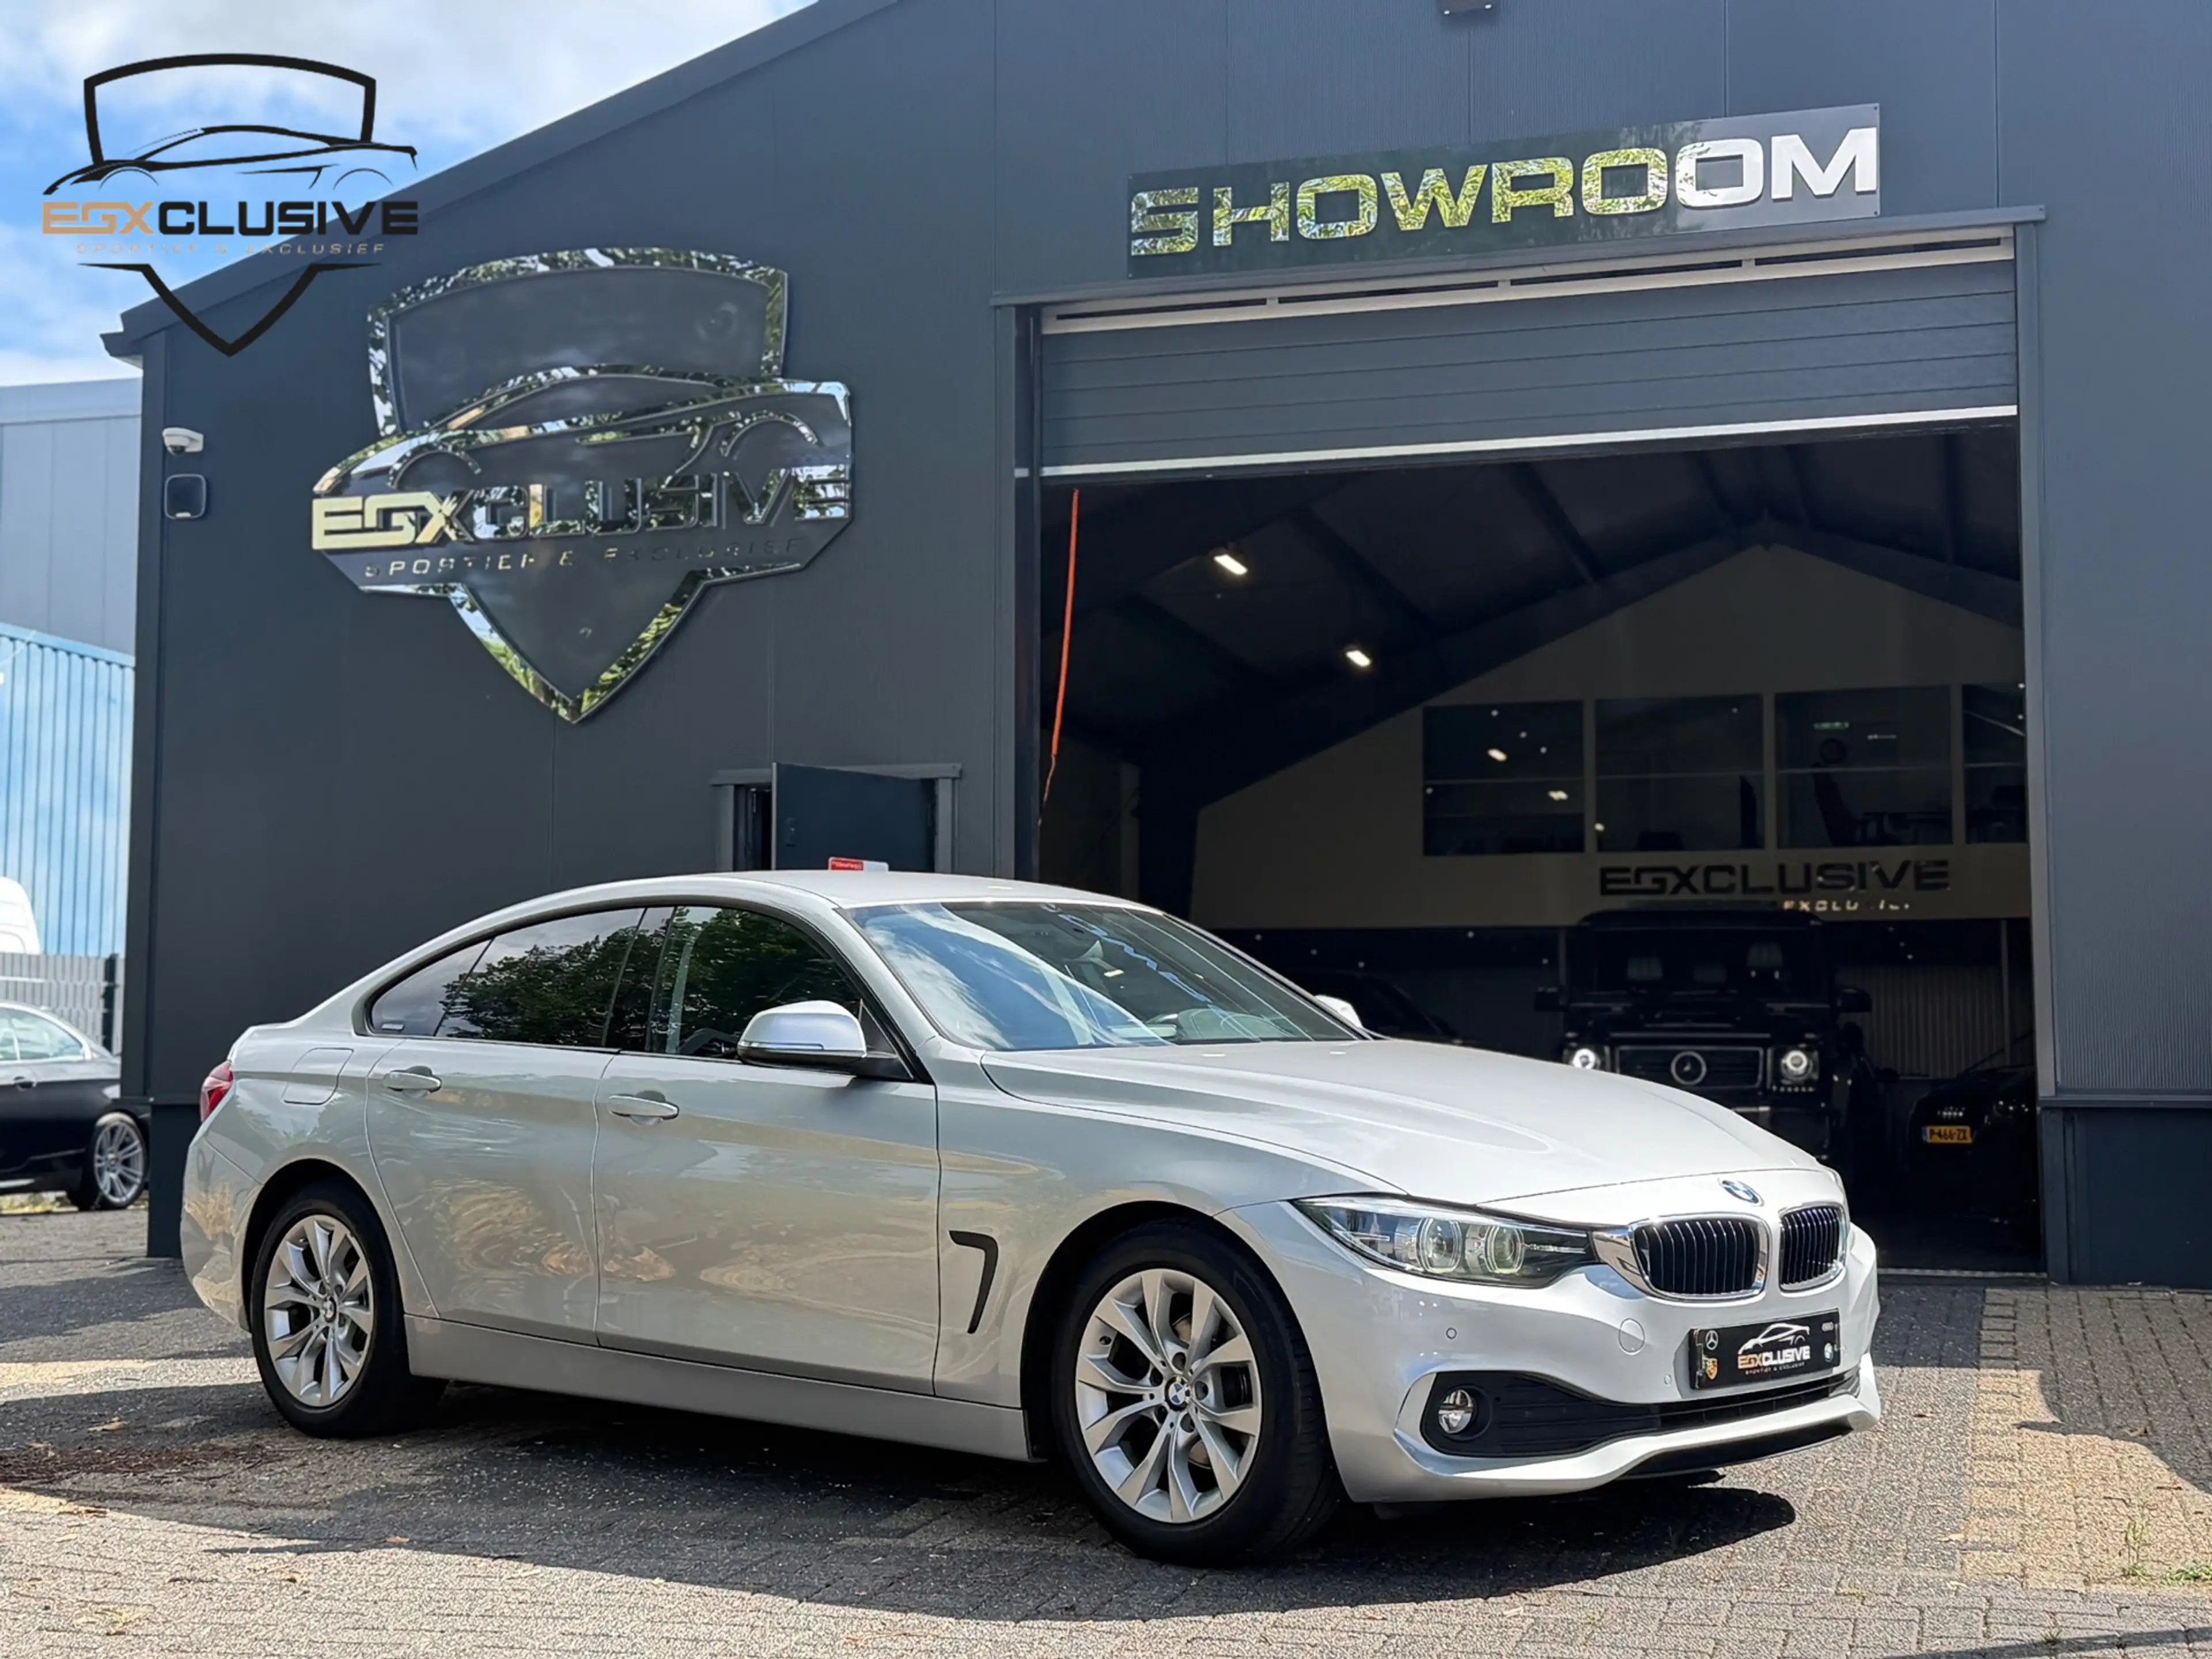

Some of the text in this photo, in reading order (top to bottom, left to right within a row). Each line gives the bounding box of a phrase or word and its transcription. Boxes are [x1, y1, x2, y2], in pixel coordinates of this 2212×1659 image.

[1130, 127, 1877, 256] SHOWROOM
[312, 464, 851, 550] EGXCLUSIVE
[1600, 859, 1951, 896] EGXCLUSIVE
